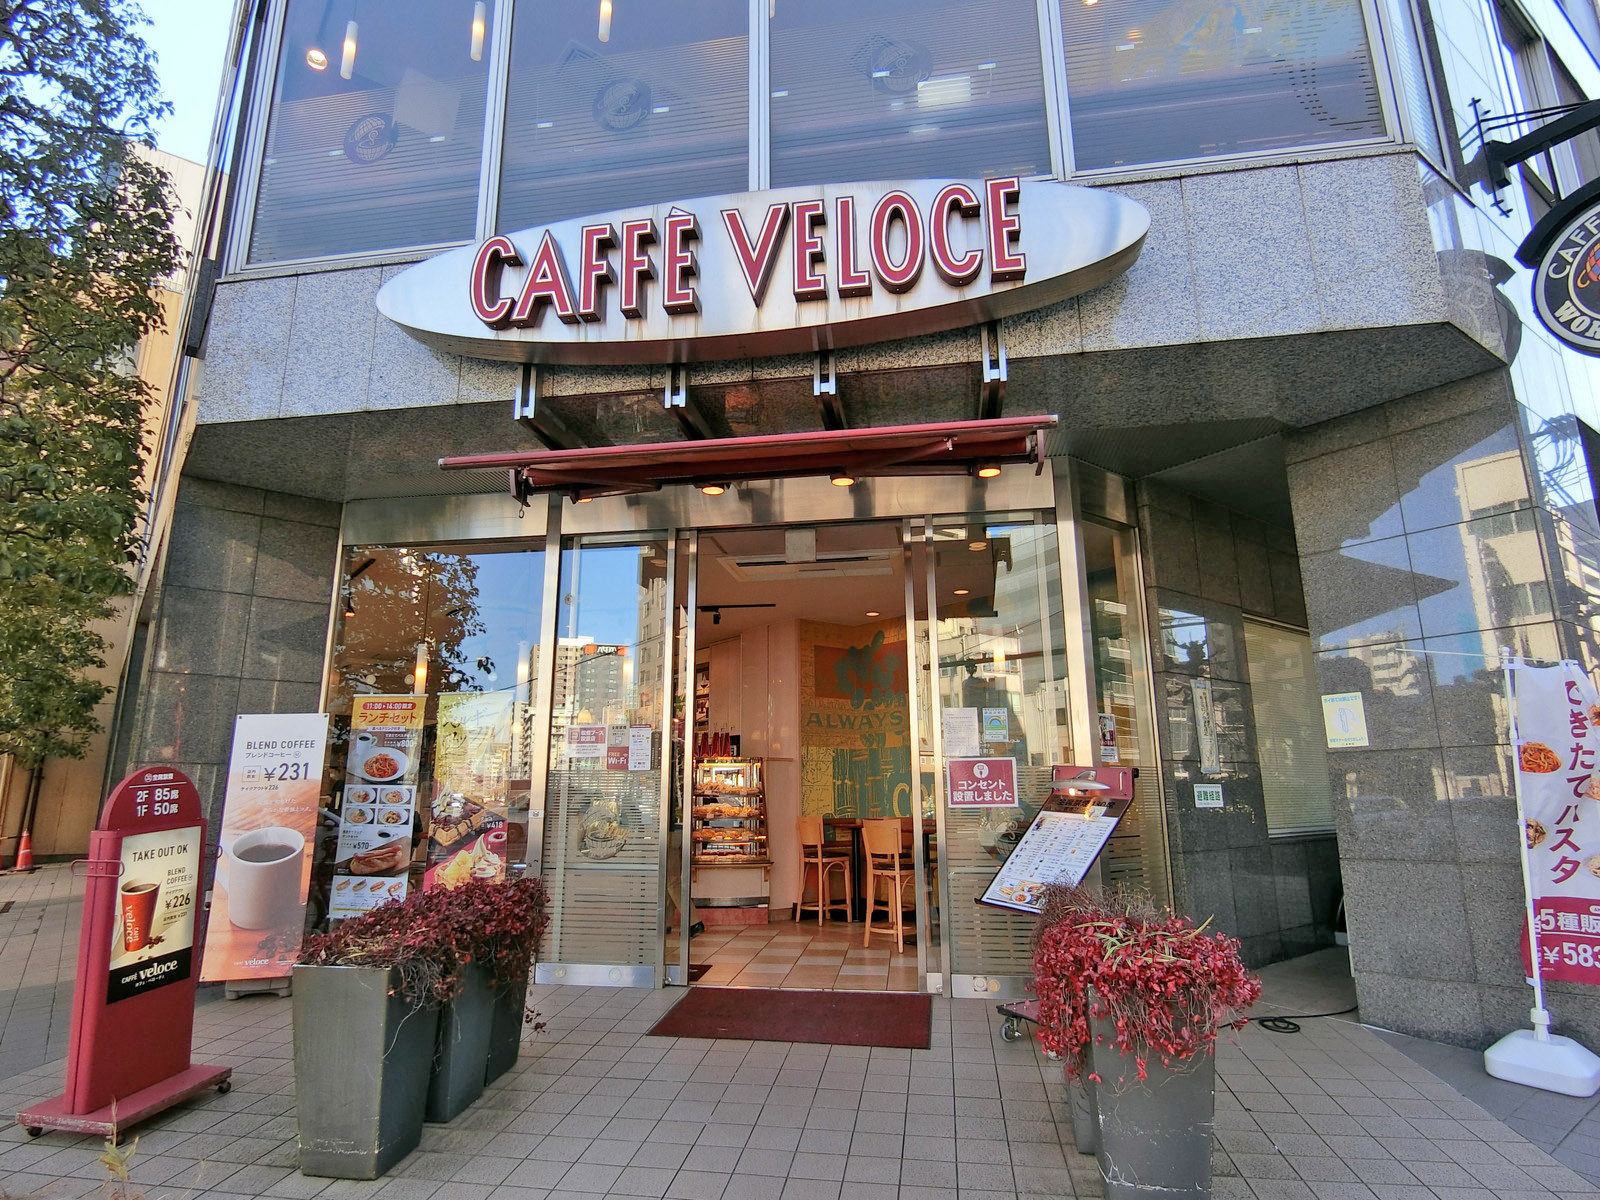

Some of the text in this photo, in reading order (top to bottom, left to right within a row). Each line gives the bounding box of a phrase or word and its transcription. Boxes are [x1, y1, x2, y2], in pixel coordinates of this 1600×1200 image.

[721, 177, 1027, 305] VELOCE
[359, 712, 416, 724] ランチセット
[805, 710, 904, 730] ALWAYS
[246, 740, 316, 750] BLEND COFFEE
[607, 757, 627, 765] Wi-Fi
[264, 762, 309, 781] ¥231
[958, 779, 1006, 790] コンセント
[136, 790, 149, 802] 2F
[953, 790, 1012, 802] 設置しました
[137, 805, 149, 816] 1F
[132, 844, 188, 862] TAKE OUT OK
[167, 867, 186, 877] BLEND
[166, 875, 188, 885] COFFEE
[165, 893, 191, 910] ¥226
[125, 905, 133, 944] veloce
[139, 960, 178, 980] veloce
